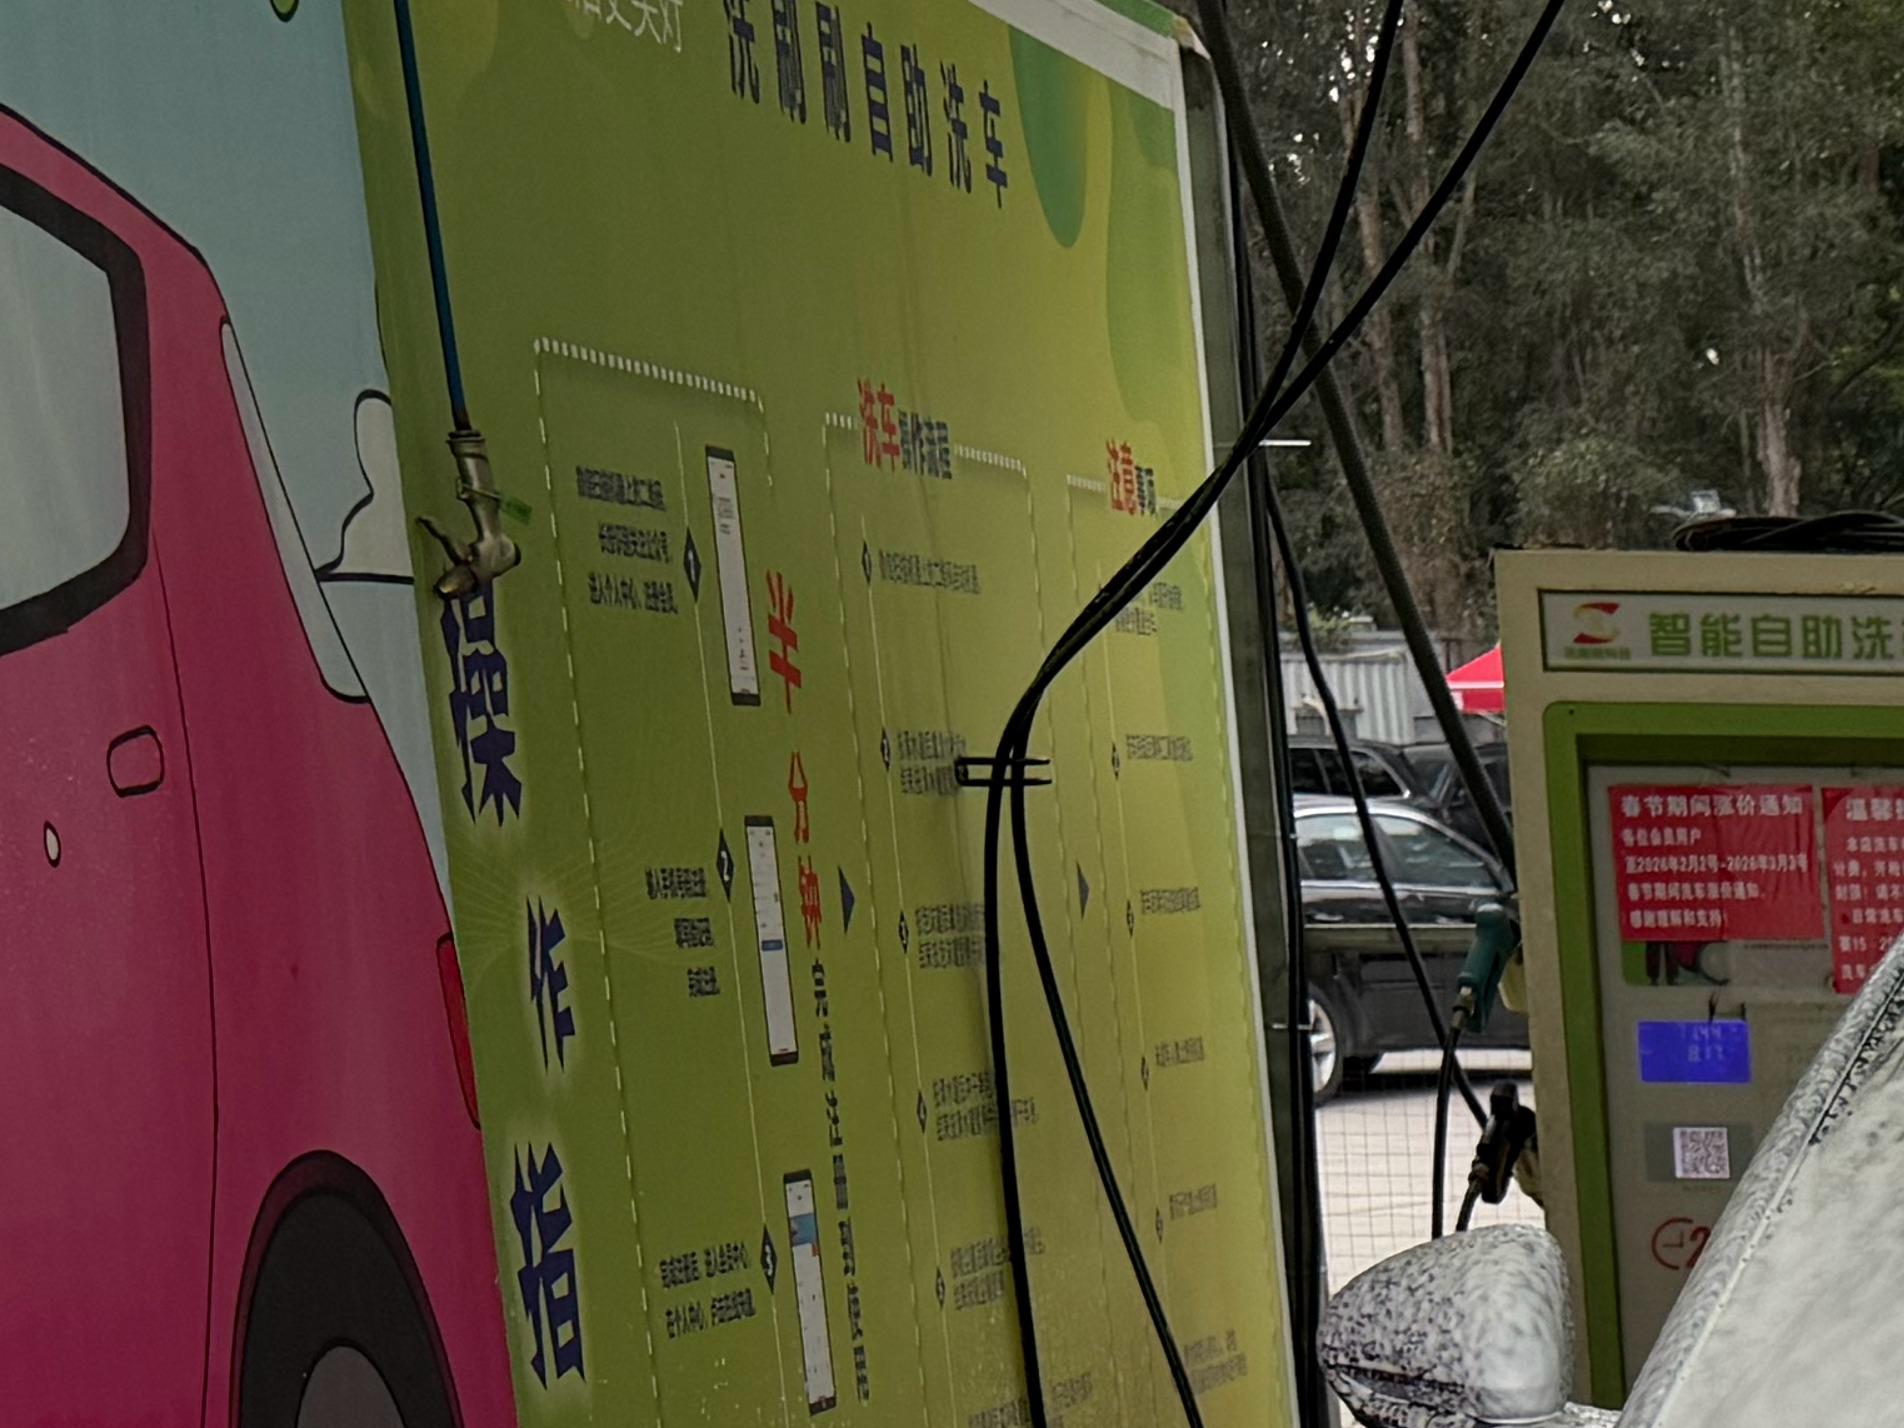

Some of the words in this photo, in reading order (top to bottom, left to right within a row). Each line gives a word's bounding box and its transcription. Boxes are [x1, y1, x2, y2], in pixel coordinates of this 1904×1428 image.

[722, 0, 1007, 210] 洗刷刷自助洗车
[1621, 795, 1803, 817] 春节期间涨价通知
